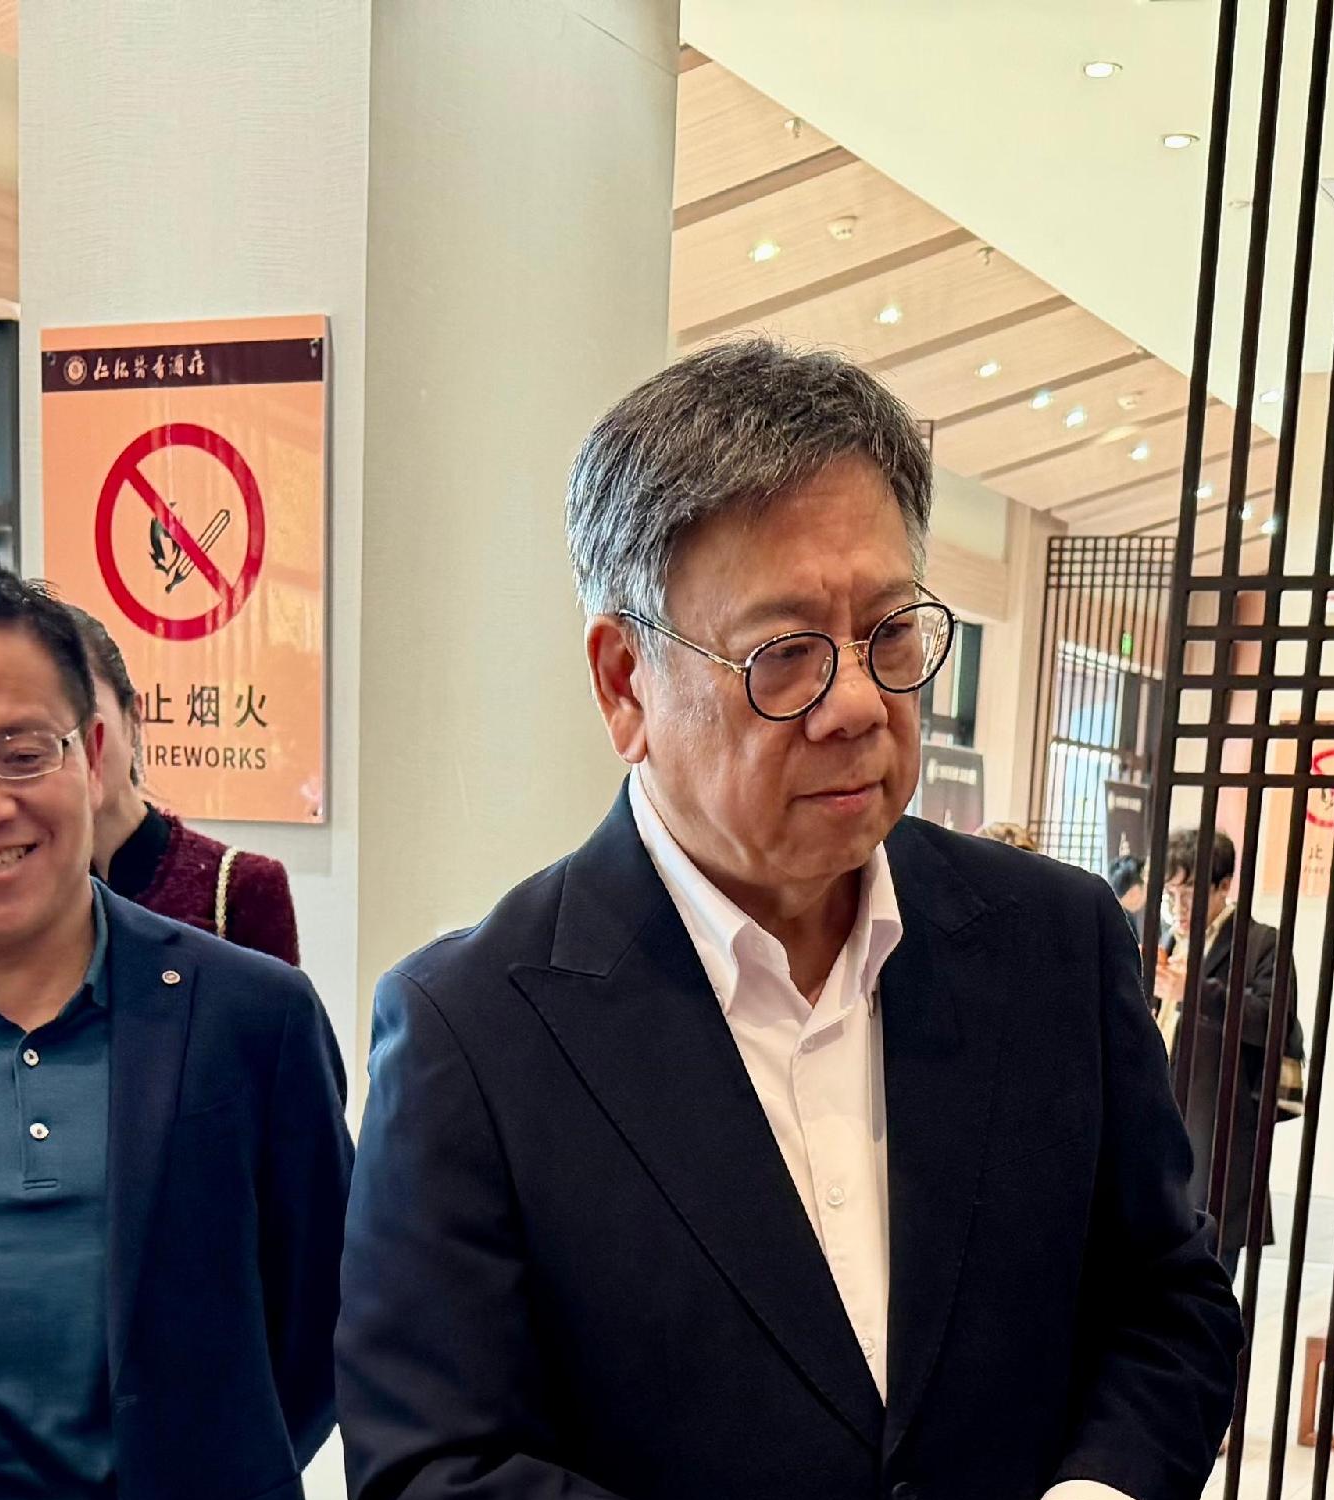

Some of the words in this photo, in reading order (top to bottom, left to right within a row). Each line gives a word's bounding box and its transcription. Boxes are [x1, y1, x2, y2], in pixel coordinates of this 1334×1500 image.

[143, 684, 268, 728] 止烟火
[147, 745, 267, 769] IREWORKS
